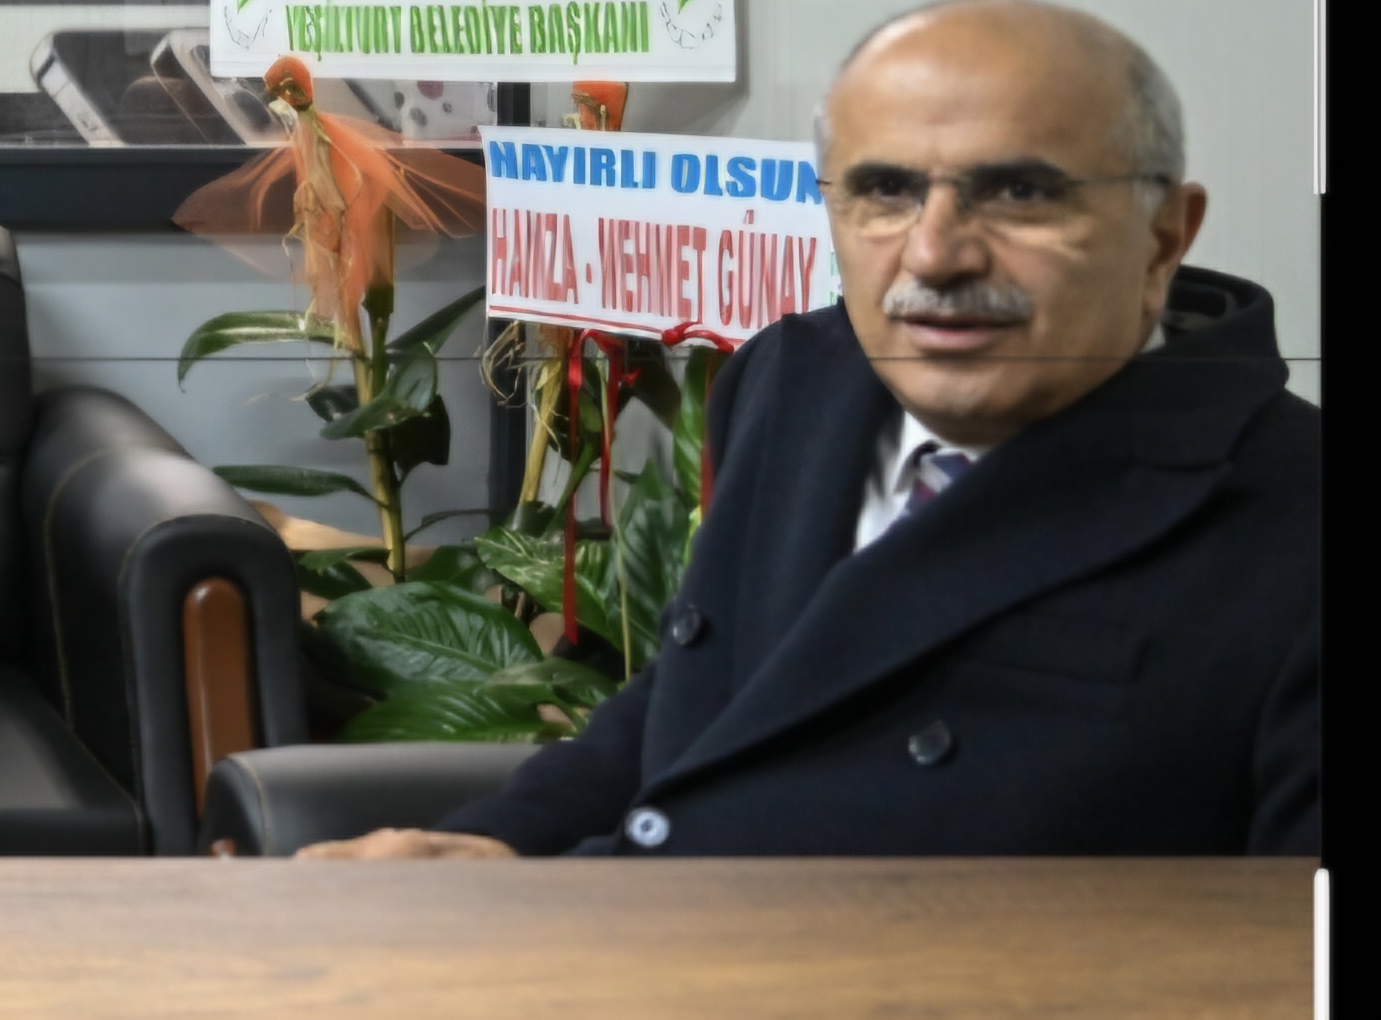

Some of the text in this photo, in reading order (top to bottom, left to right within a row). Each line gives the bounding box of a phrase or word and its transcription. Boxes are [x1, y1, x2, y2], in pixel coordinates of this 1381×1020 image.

[528, 0, 649, 66] BAŞKANI
[670, 153, 824, 205] OLSUN
[491, 207, 580, 305] HAMZA
[597, 216, 708, 325] MEHMET
